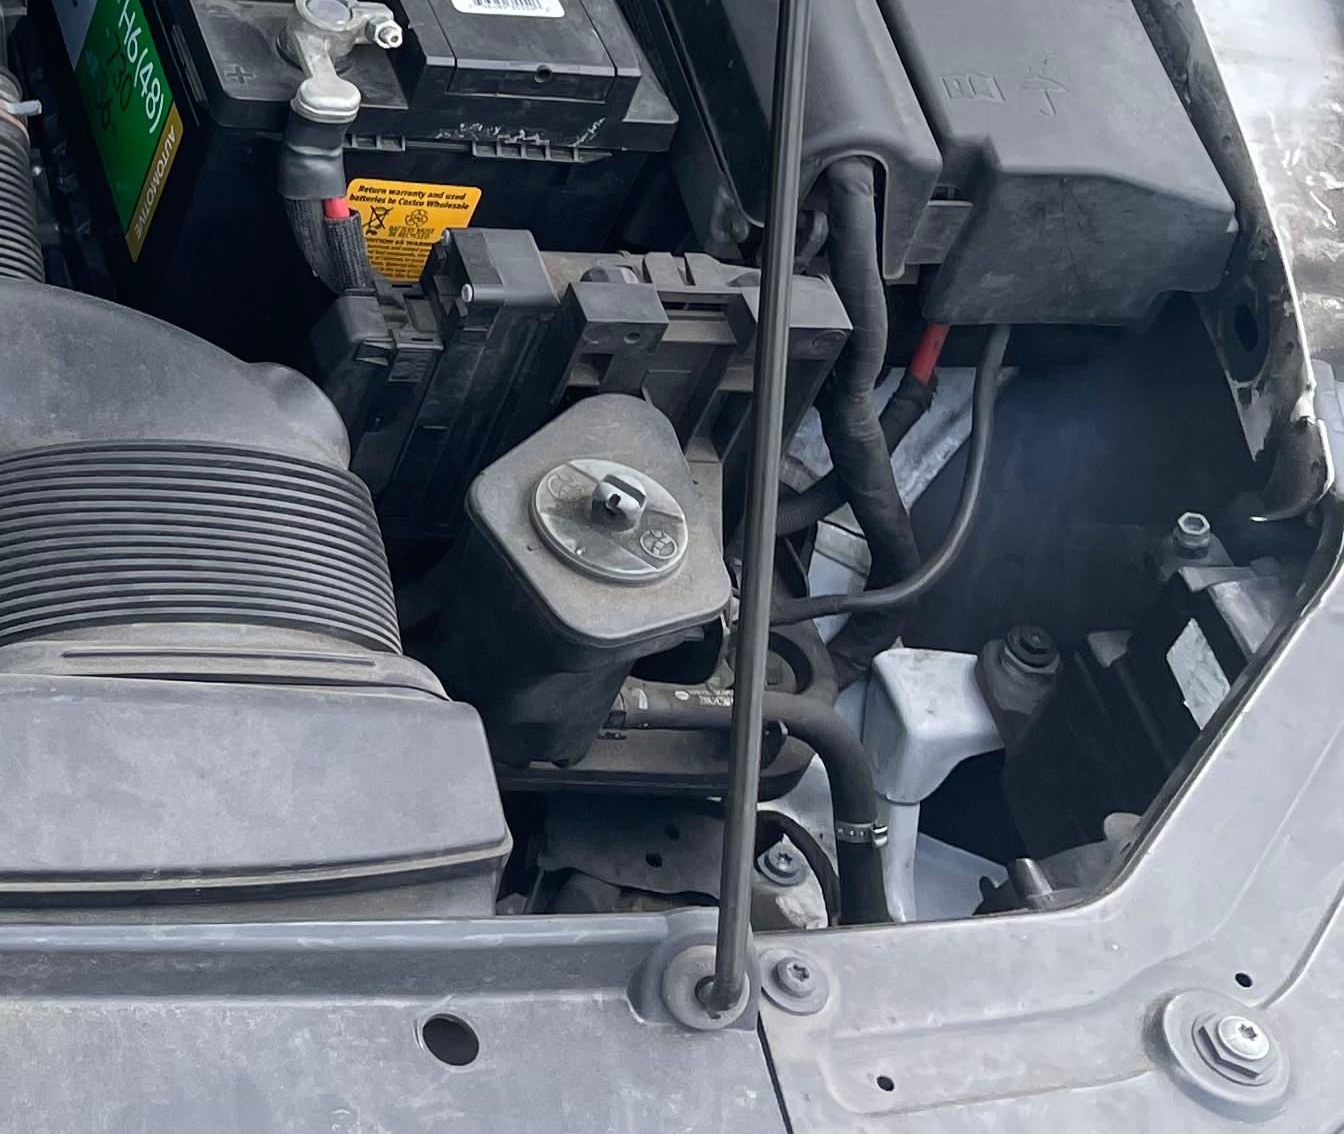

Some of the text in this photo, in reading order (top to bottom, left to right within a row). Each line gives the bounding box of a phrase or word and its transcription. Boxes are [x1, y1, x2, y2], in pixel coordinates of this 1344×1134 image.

[133, 123, 176, 241] AUTOMOTIVE
[349, 193, 387, 204] batteries
[426, 199, 470, 210] Wholesale
[358, 185, 387, 196] Return
[388, 189, 426, 201] warranty
[445, 193, 467, 201] used
